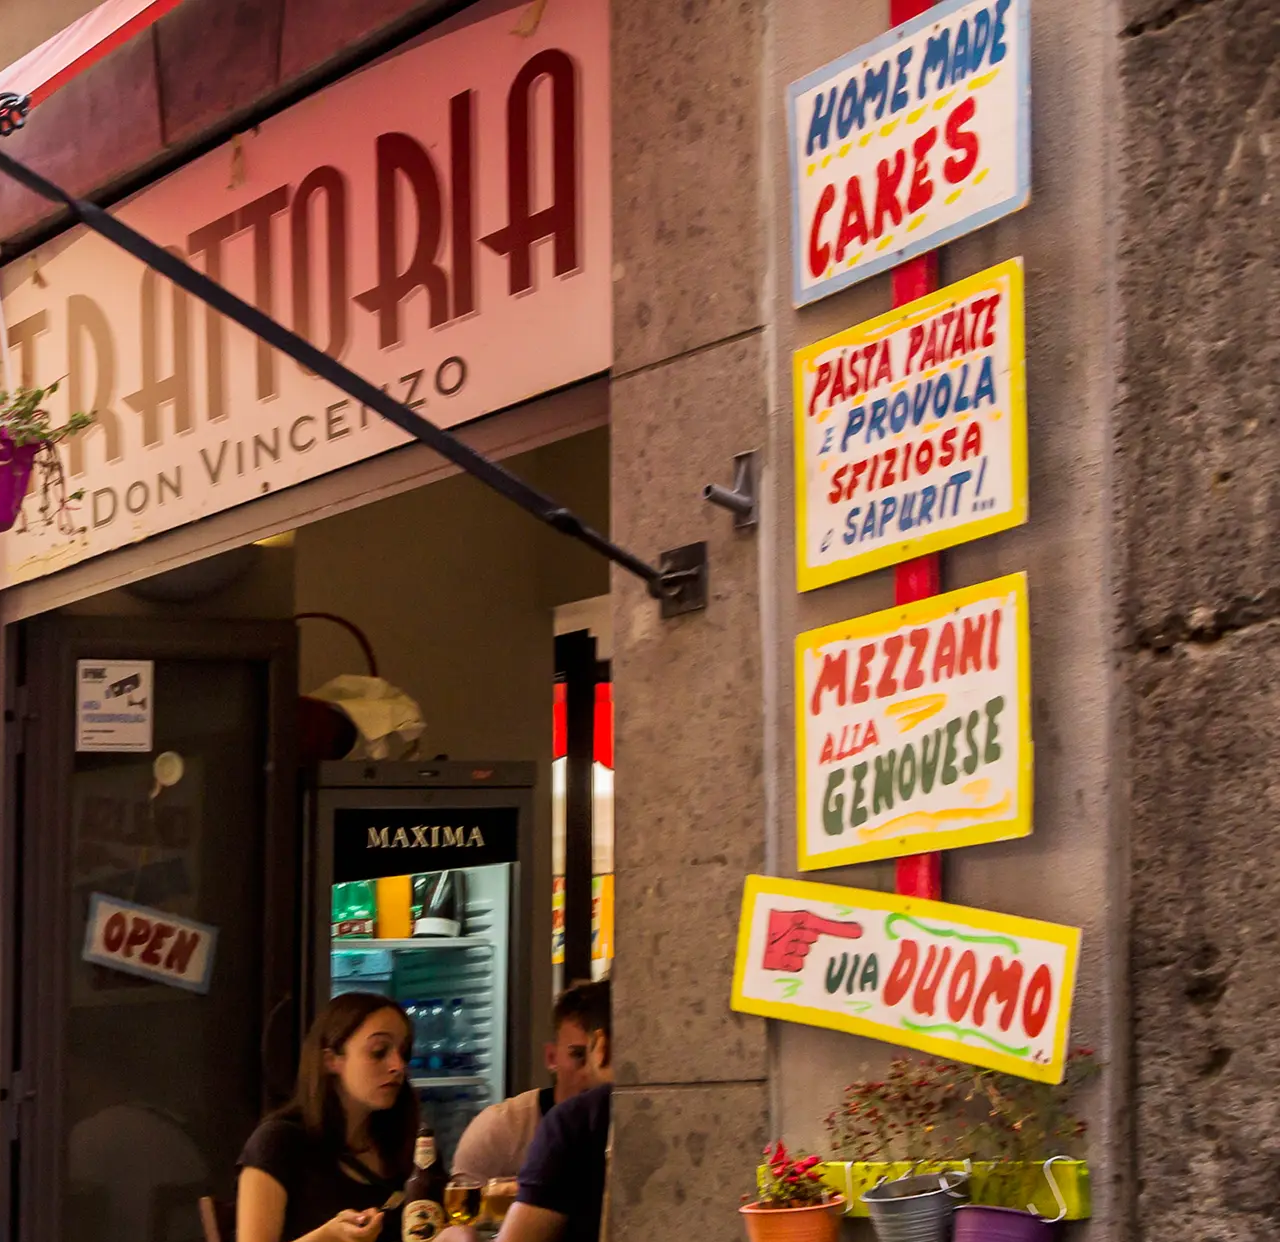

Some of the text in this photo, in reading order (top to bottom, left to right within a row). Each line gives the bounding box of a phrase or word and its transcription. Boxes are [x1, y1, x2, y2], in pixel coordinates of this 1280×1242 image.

[806, 0, 1011, 158] HOME MADE
[808, 95, 980, 280] CAKES
[7, 47, 585, 490] TRATTORIA
[809, 292, 1002, 417] PASTA PATATE
[841, 355, 997, 453] PROVOLA
[90, 464, 184, 529] DON
[827, 421, 983, 505] SFIZIOSA
[810, 608, 1003, 717] MEZZANI
[818, 717, 881, 767] ALLA
[366, 825, 486, 849] MAXIMA
[103, 911, 201, 975] OPEN
[824, 938, 1053, 1040] VIA DUOMO
